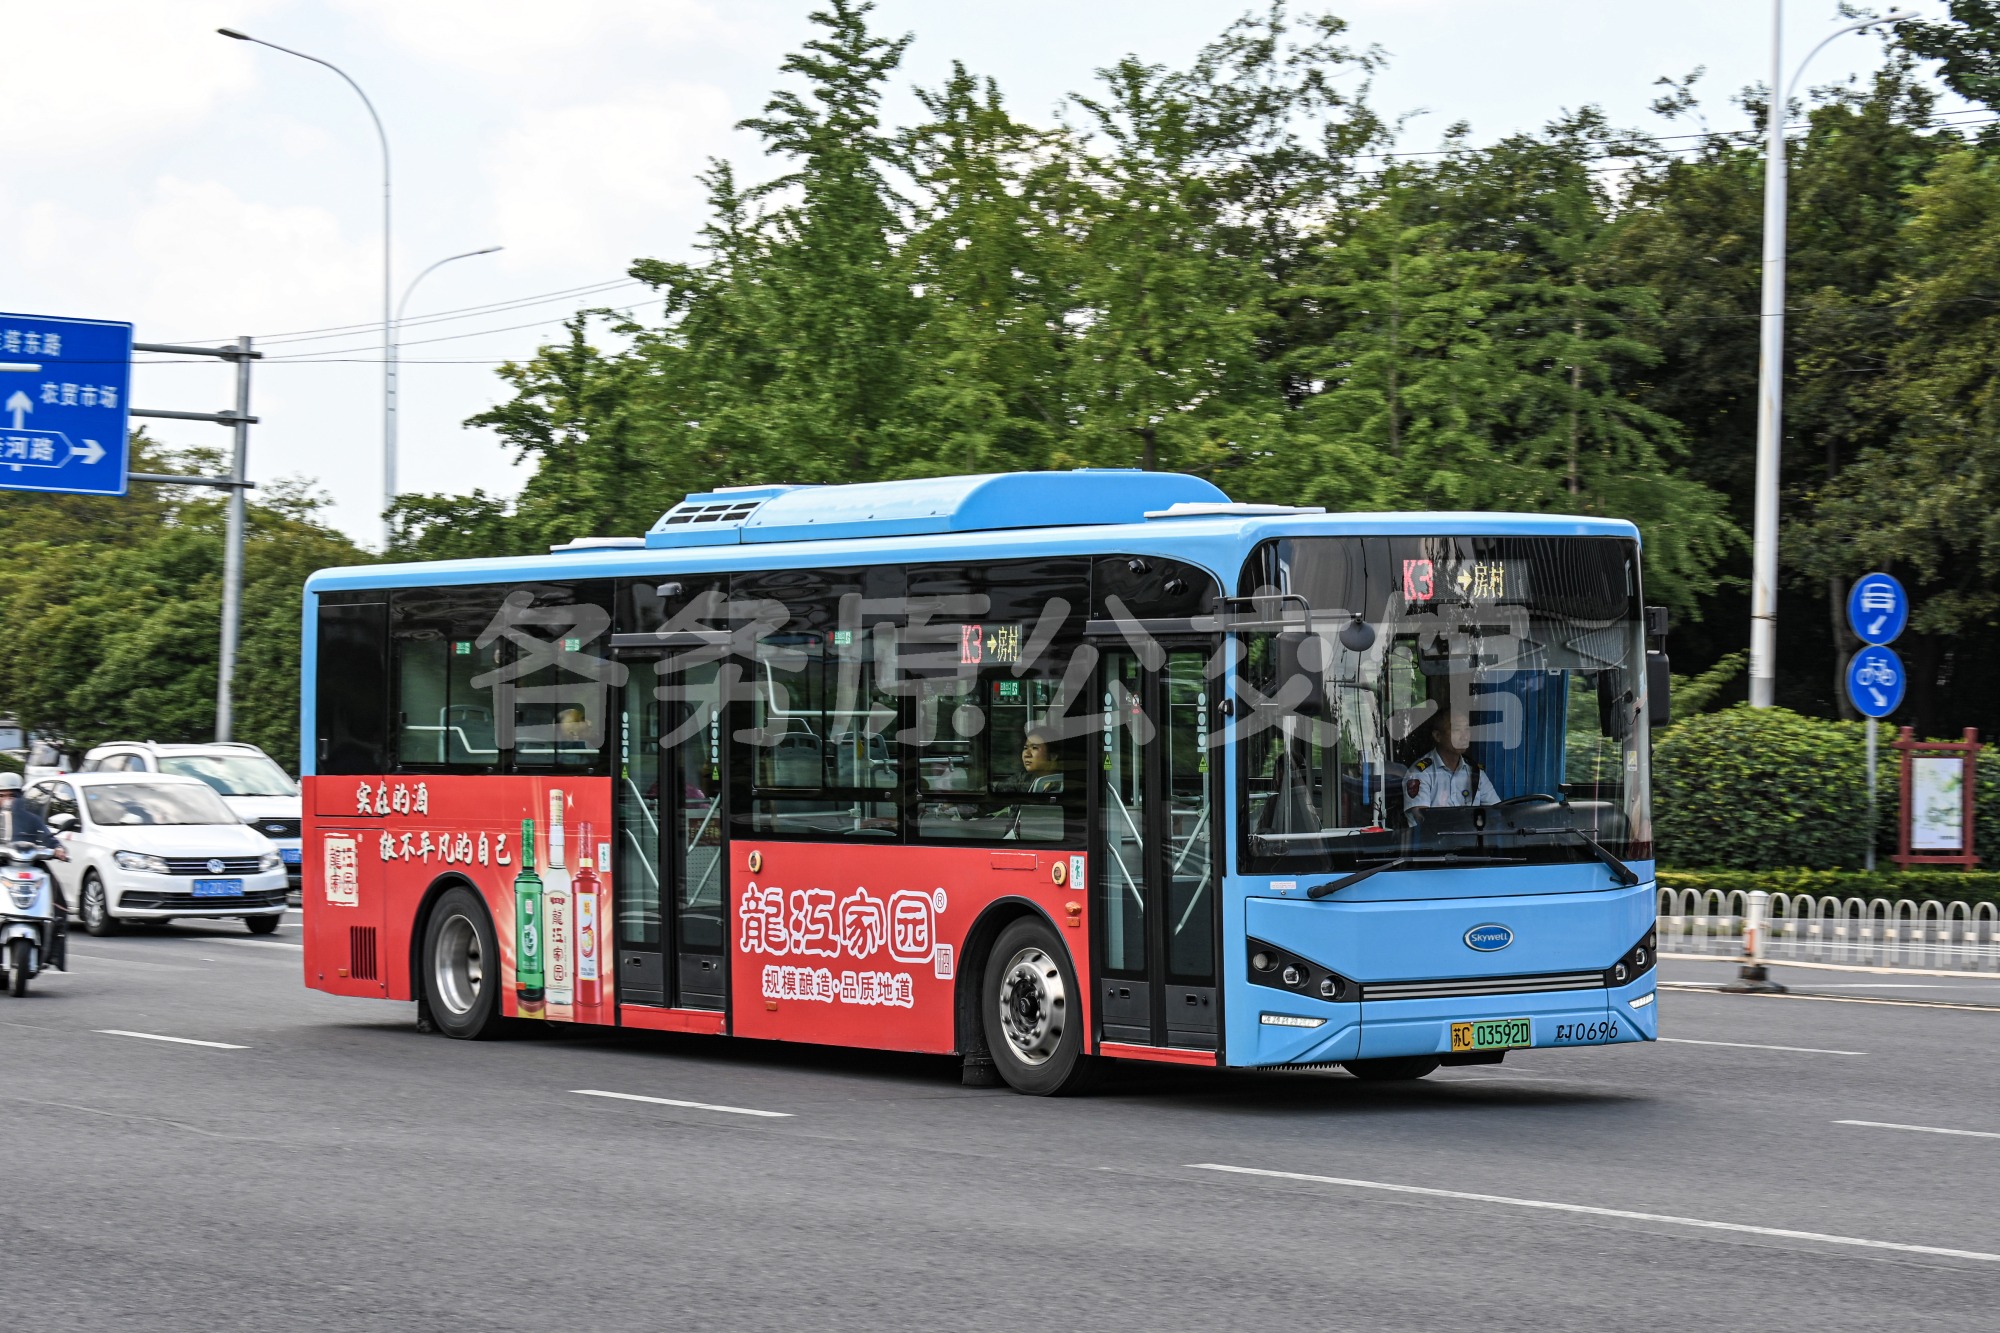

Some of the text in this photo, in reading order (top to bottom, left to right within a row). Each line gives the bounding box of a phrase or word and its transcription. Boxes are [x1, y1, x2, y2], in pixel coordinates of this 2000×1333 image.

[0, 330, 62, 357] 塔东路
[40, 381, 118, 409] 农贸市场
[0, 436, 55, 461] 河路
[1403, 559, 1504, 600] K3 房村
[961, 624, 982, 664] K3
[356, 781, 429, 815] 实在的酒
[1471, 932, 1508, 943] Skywell
